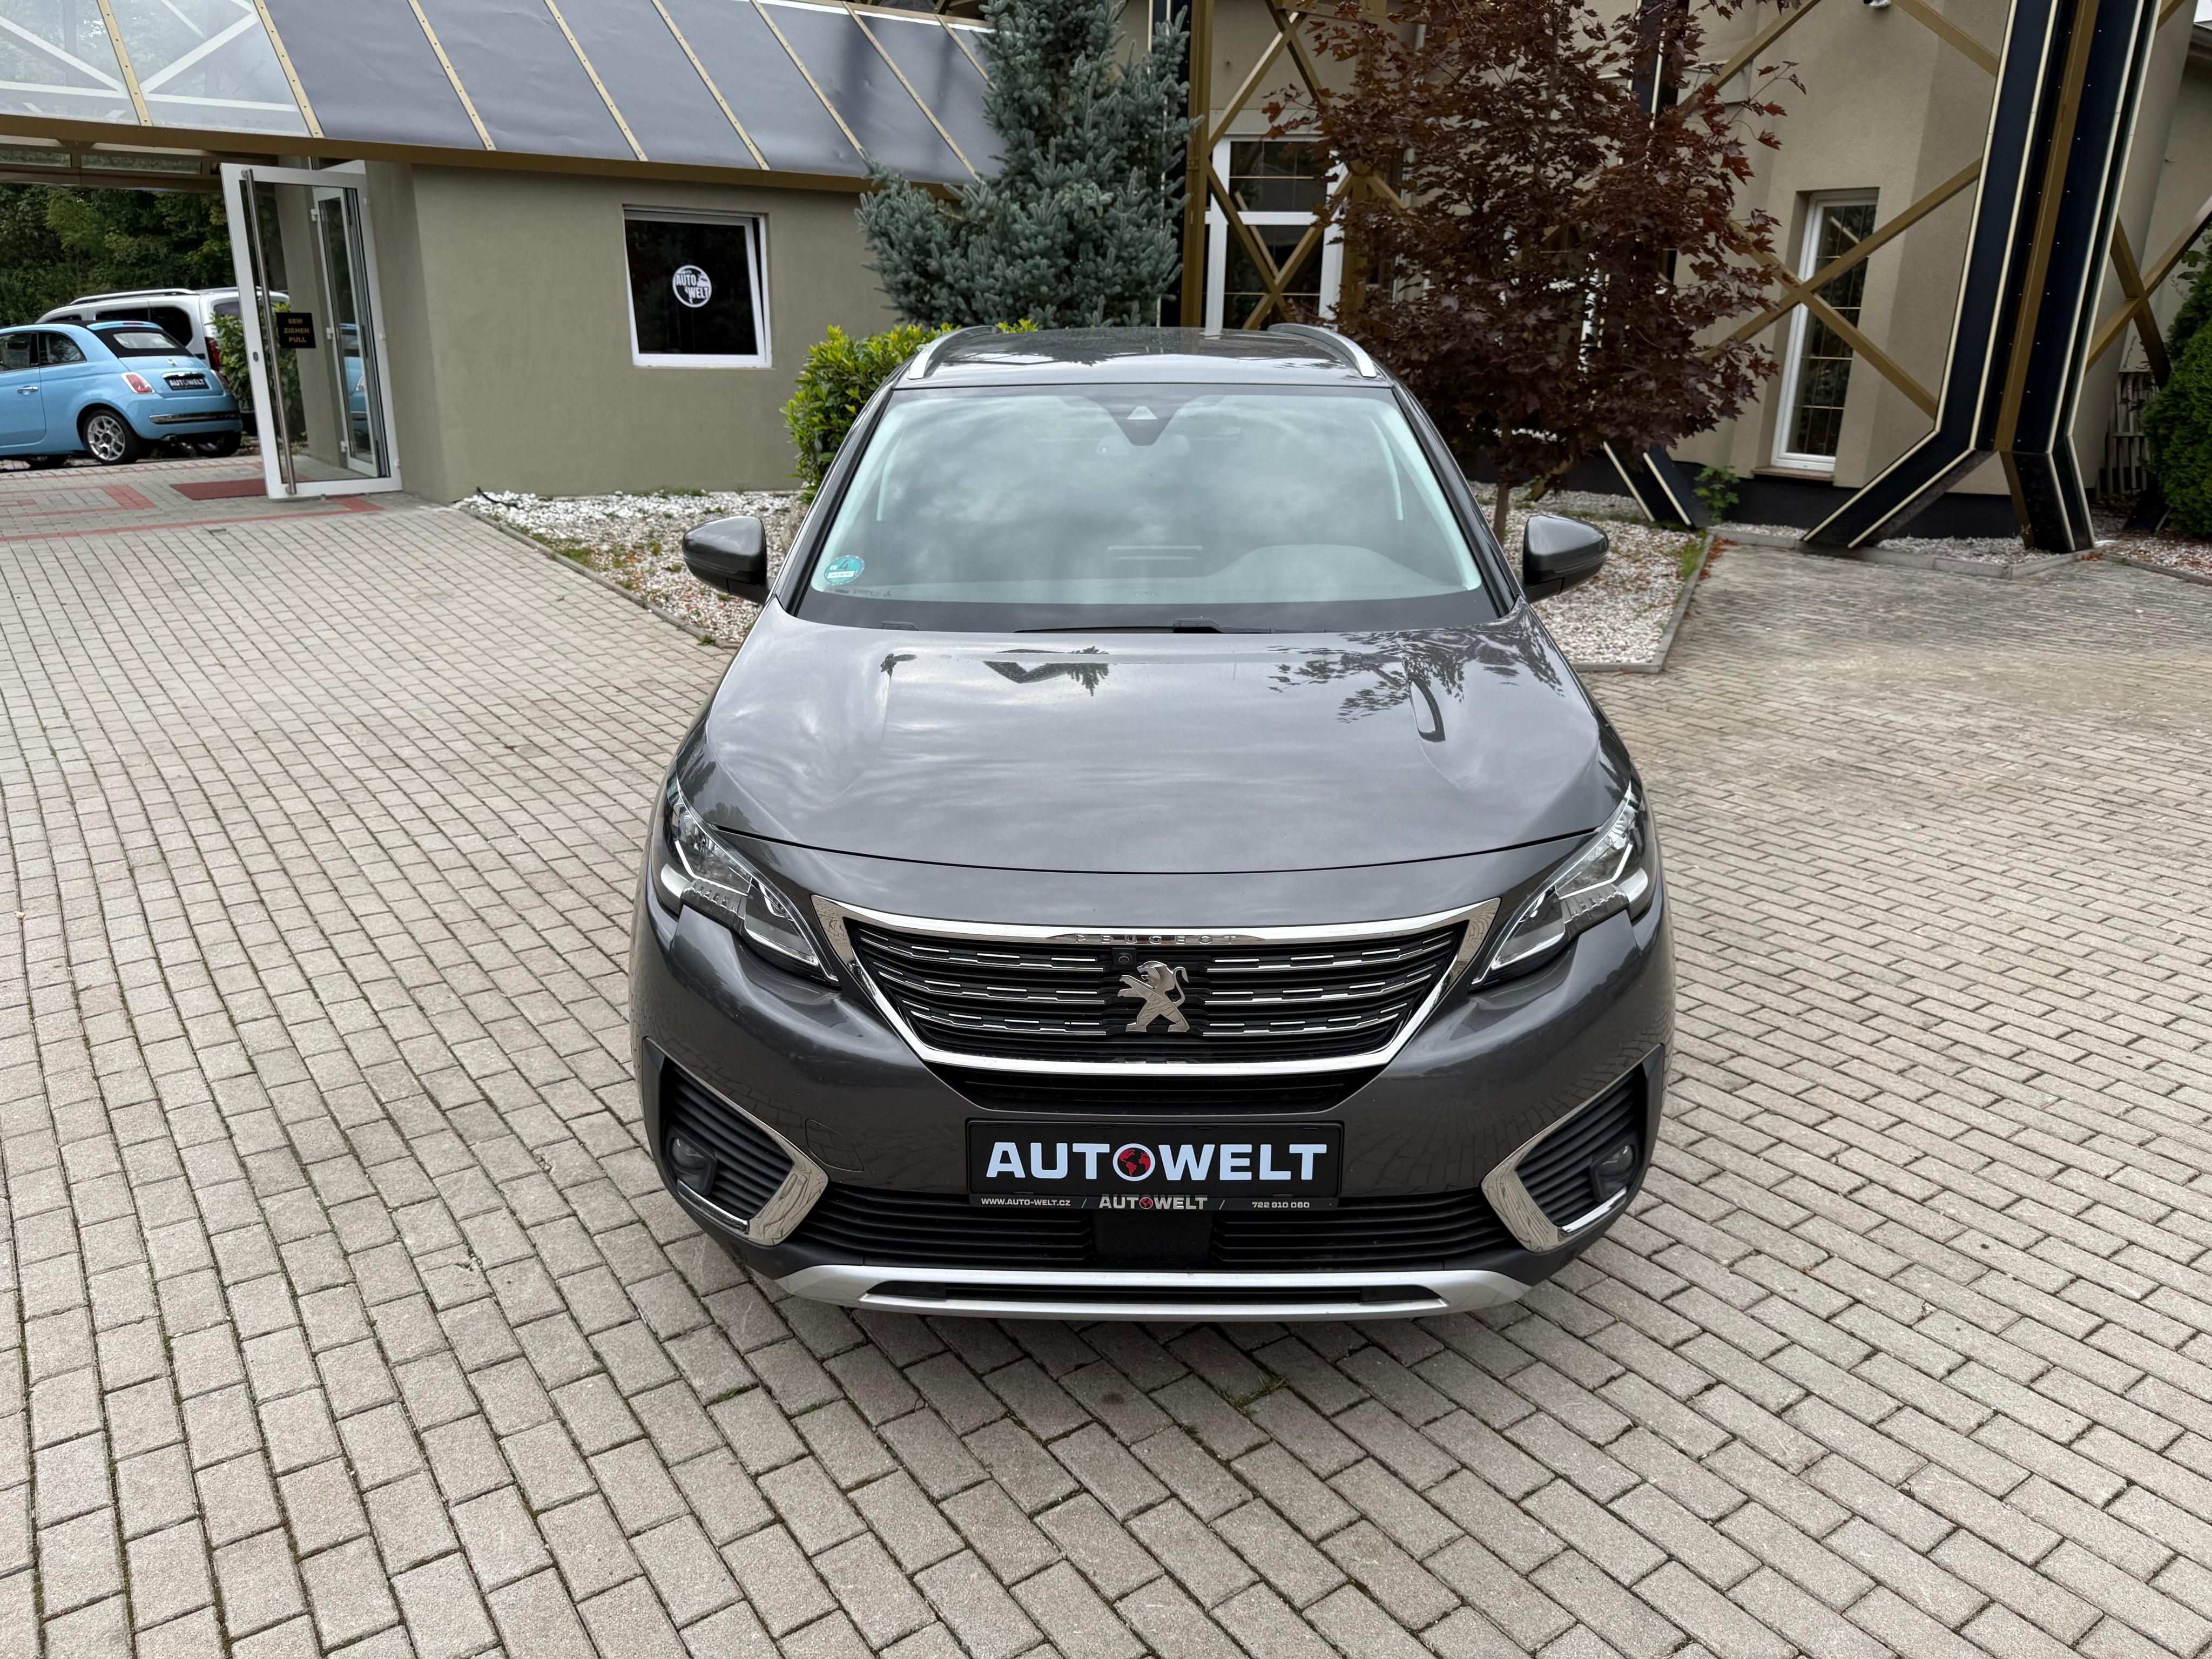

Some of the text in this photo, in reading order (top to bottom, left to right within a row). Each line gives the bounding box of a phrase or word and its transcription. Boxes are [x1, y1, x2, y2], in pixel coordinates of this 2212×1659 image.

[676, 274, 697, 286] AUTO
[688, 287, 709, 299] WELT
[169, 379, 205, 387] AUTOWELT
[838, 559, 849, 570] 4
[1075, 934, 1237, 945] PEUGEOT
[986, 1142, 1327, 1182] AUTOWELT
[981, 1198, 1071, 1206] WWW.AUTO-WELT.CZ
[1098, 1196, 1208, 1210] AUTOWELT
